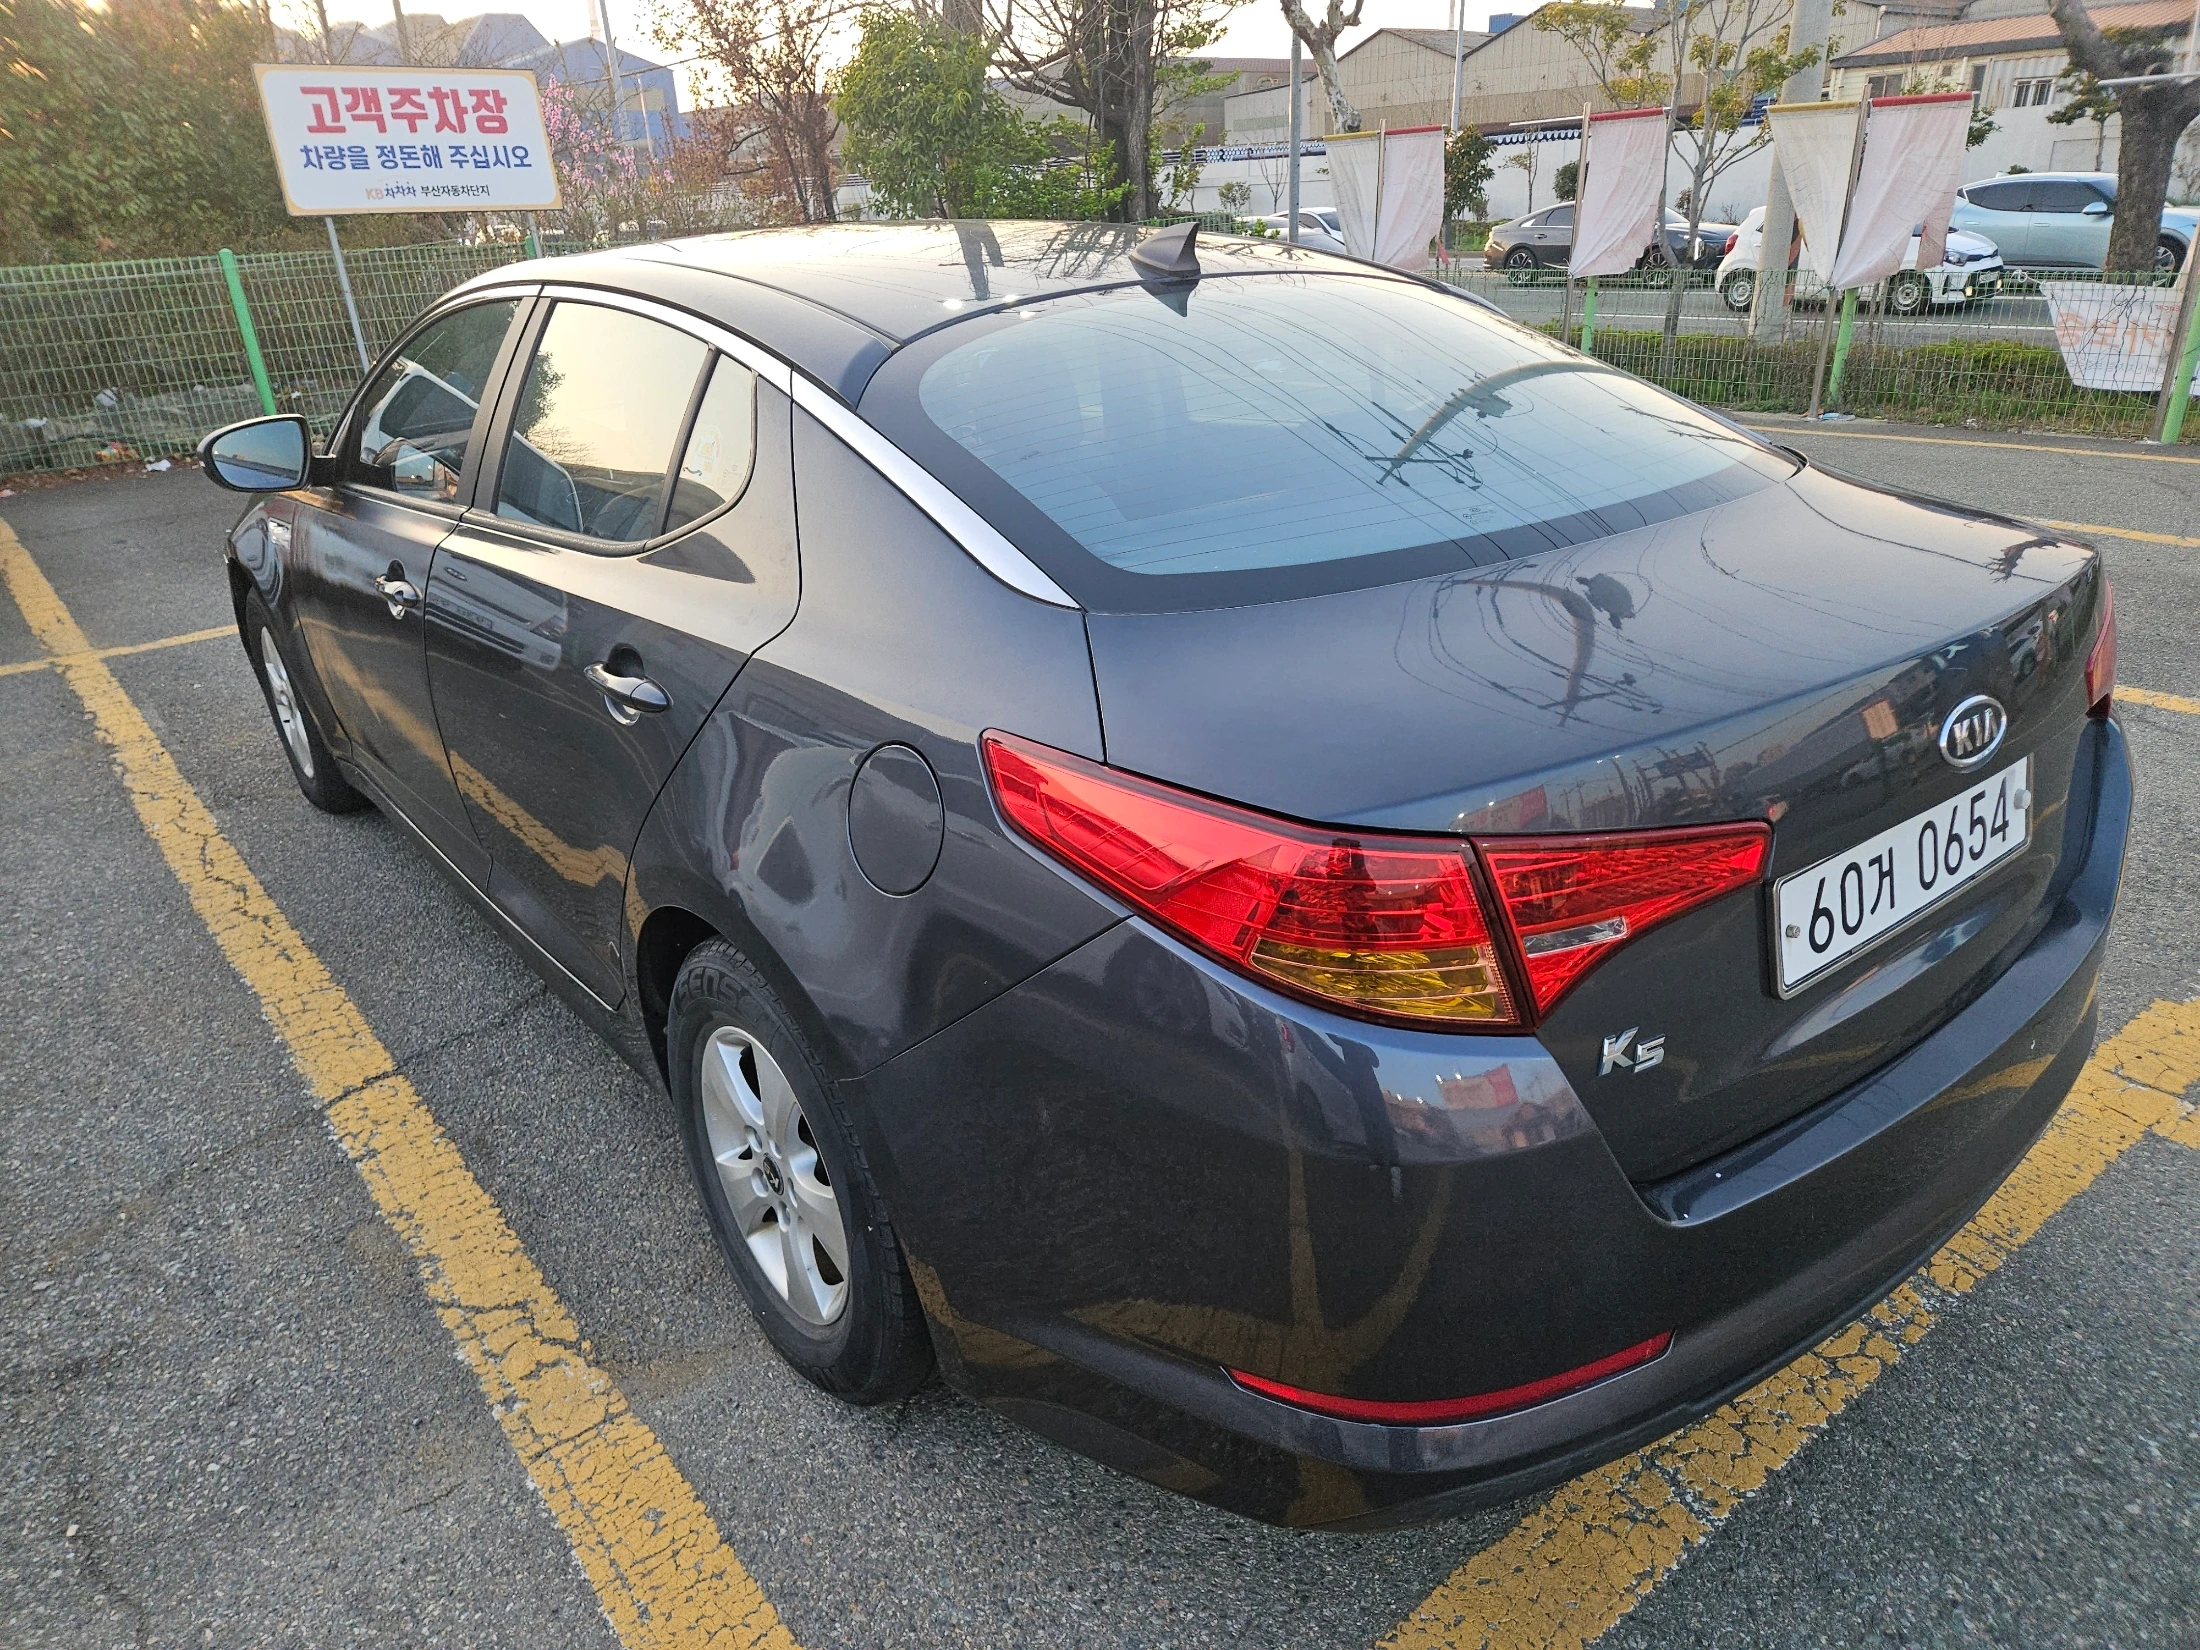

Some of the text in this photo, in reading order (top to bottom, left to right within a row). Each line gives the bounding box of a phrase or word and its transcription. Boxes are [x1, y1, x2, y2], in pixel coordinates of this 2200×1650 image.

[299, 86, 509, 134] 고객주차장
[300, 144, 532, 170] 차량을 정돈해 주십시오
[420, 184, 490, 197] 부산자동차단지
[1953, 708, 1999, 757] KIA
[1809, 778, 2010, 954] 60거 0654
[1599, 1027, 1666, 1076] K5
